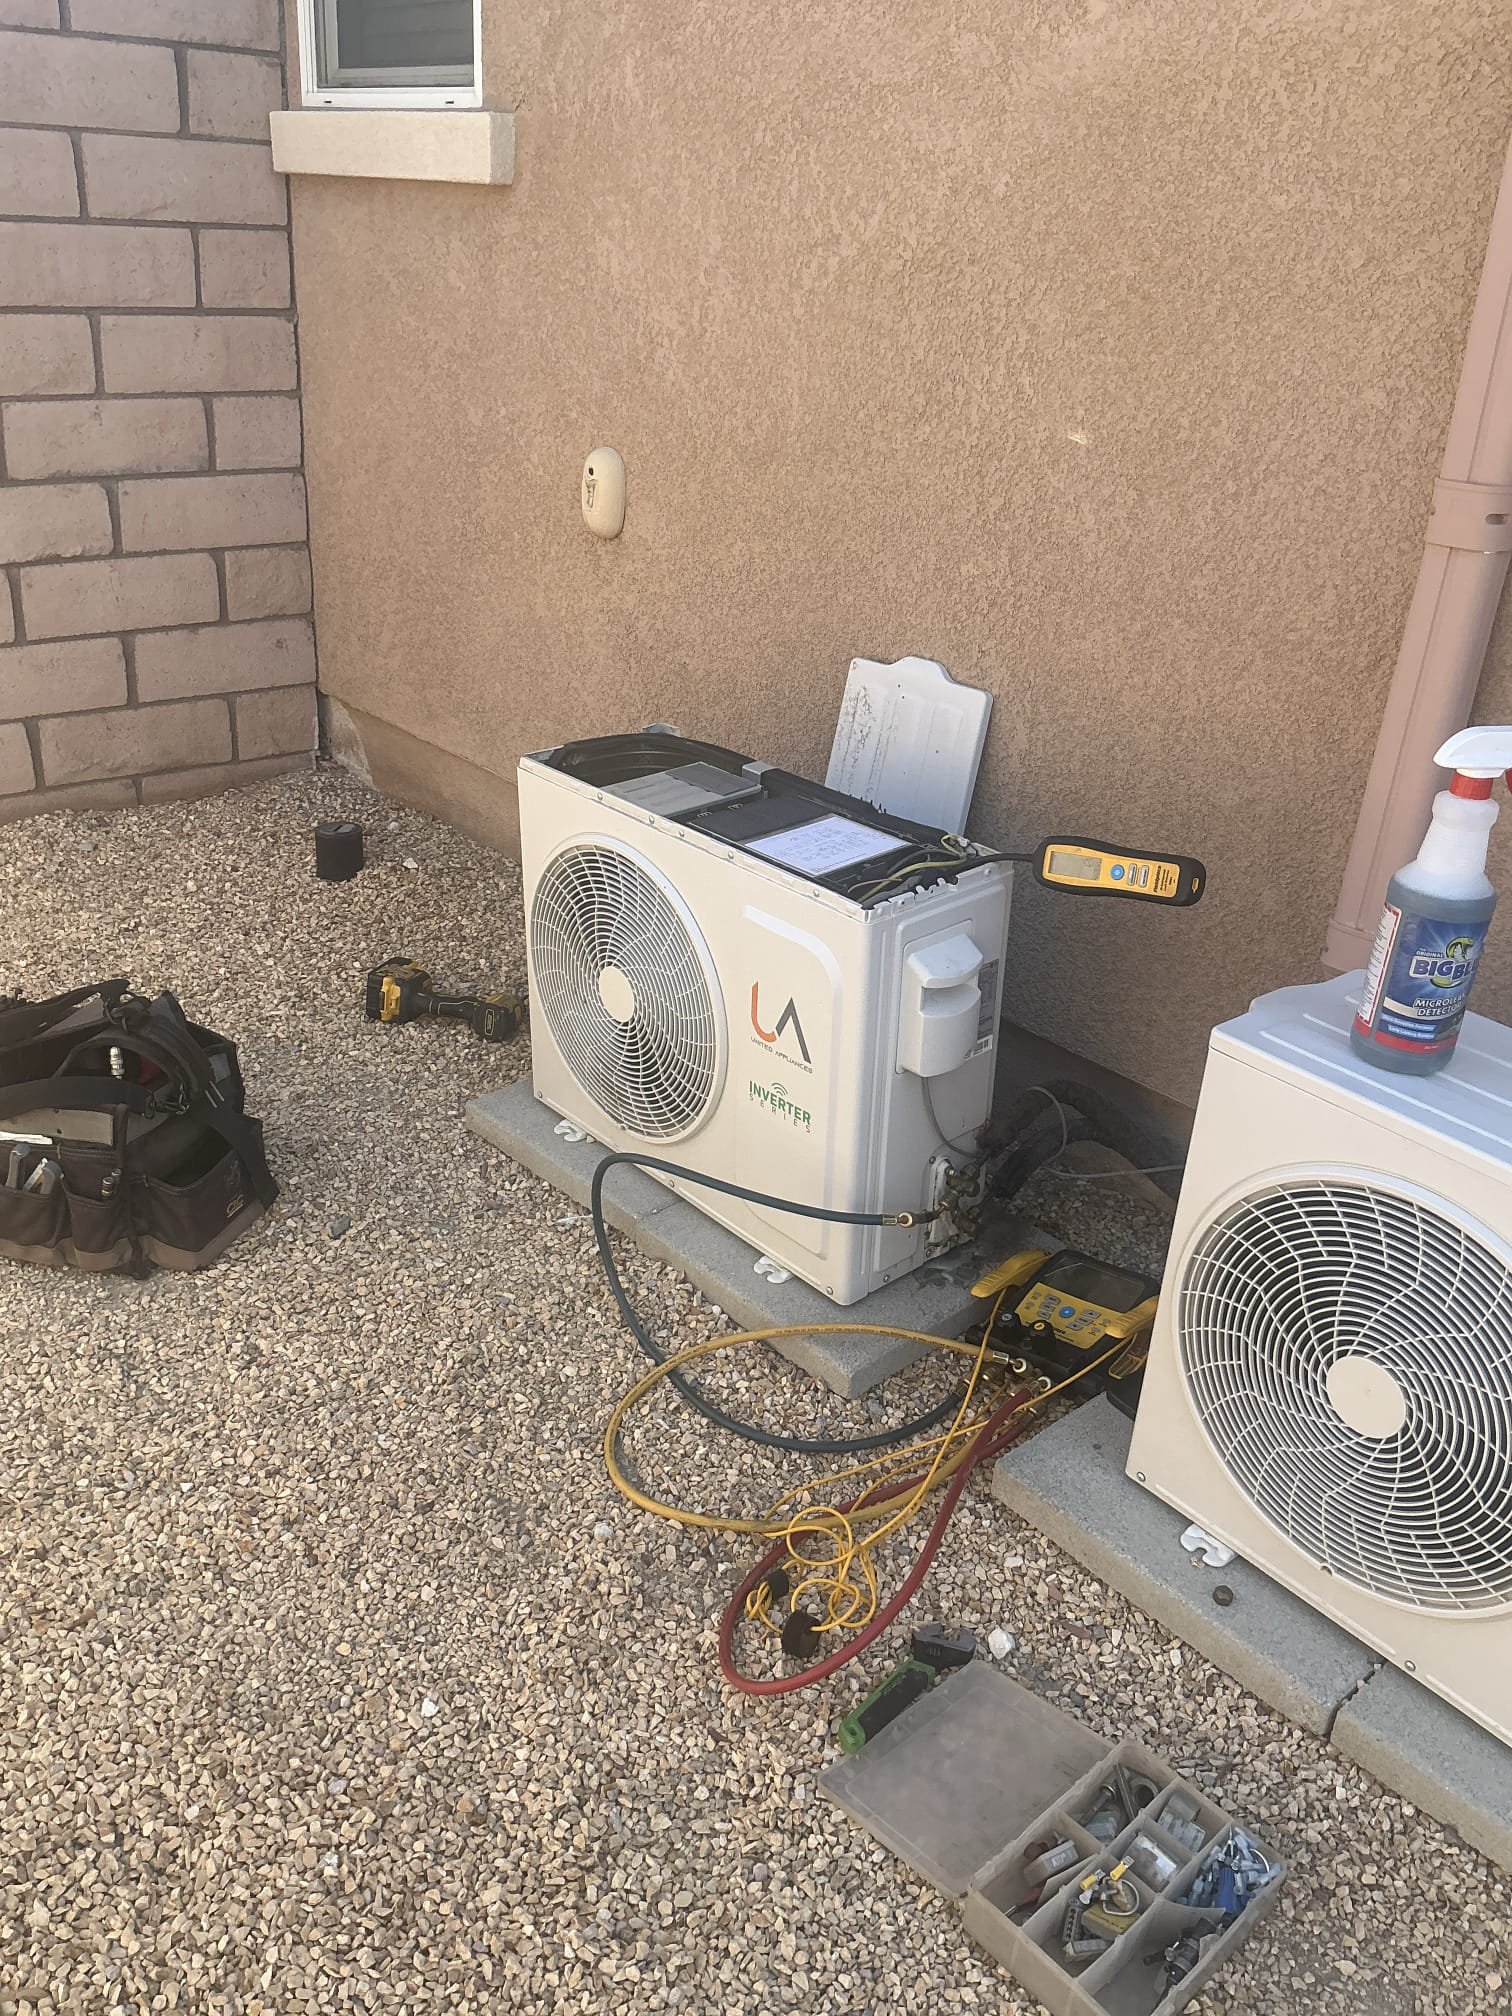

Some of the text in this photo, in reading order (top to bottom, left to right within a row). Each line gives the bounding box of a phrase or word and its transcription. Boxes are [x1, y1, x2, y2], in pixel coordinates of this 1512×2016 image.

[750, 1036, 813, 1075] UNITED APPLIANCES
[749, 1081, 811, 1125] INVERTER
[749, 1093, 811, 1134] SERIES
